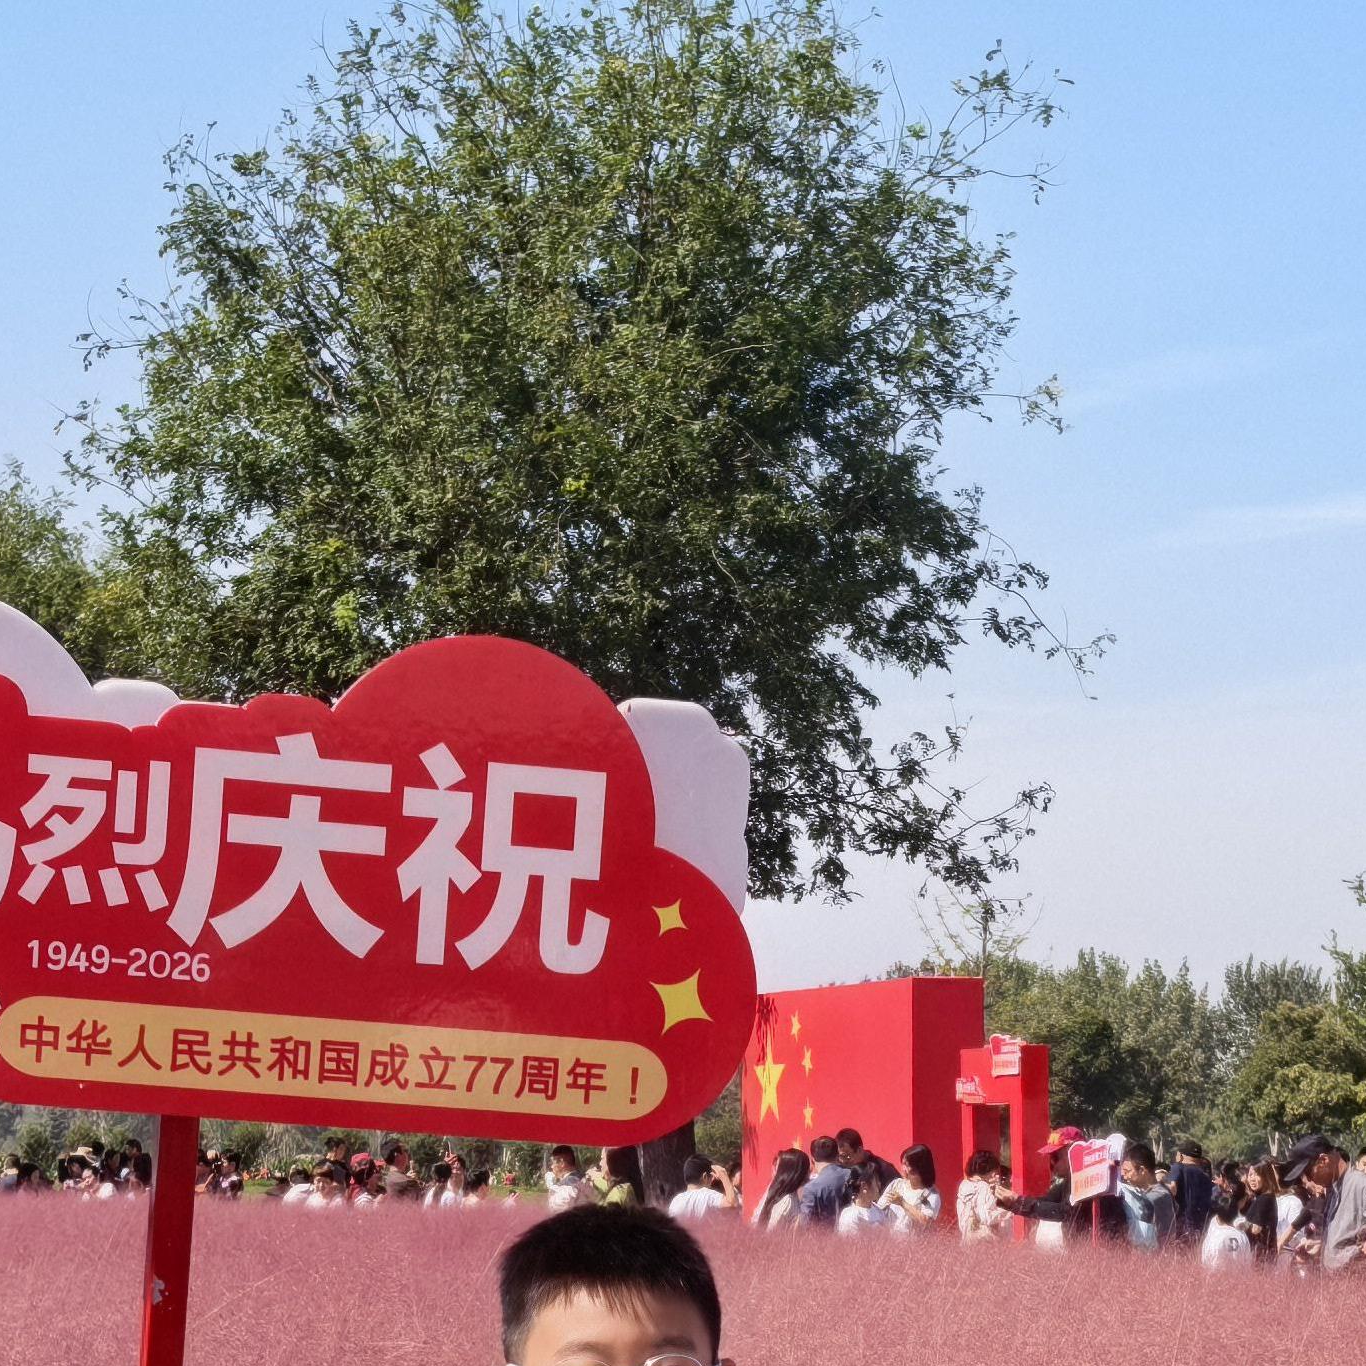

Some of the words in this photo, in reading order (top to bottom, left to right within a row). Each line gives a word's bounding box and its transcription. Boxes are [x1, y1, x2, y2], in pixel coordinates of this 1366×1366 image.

[27, 940, 212, 984] 1949-2026
[19, 1016, 641, 1106] 中华人民共和国成立77周年！
